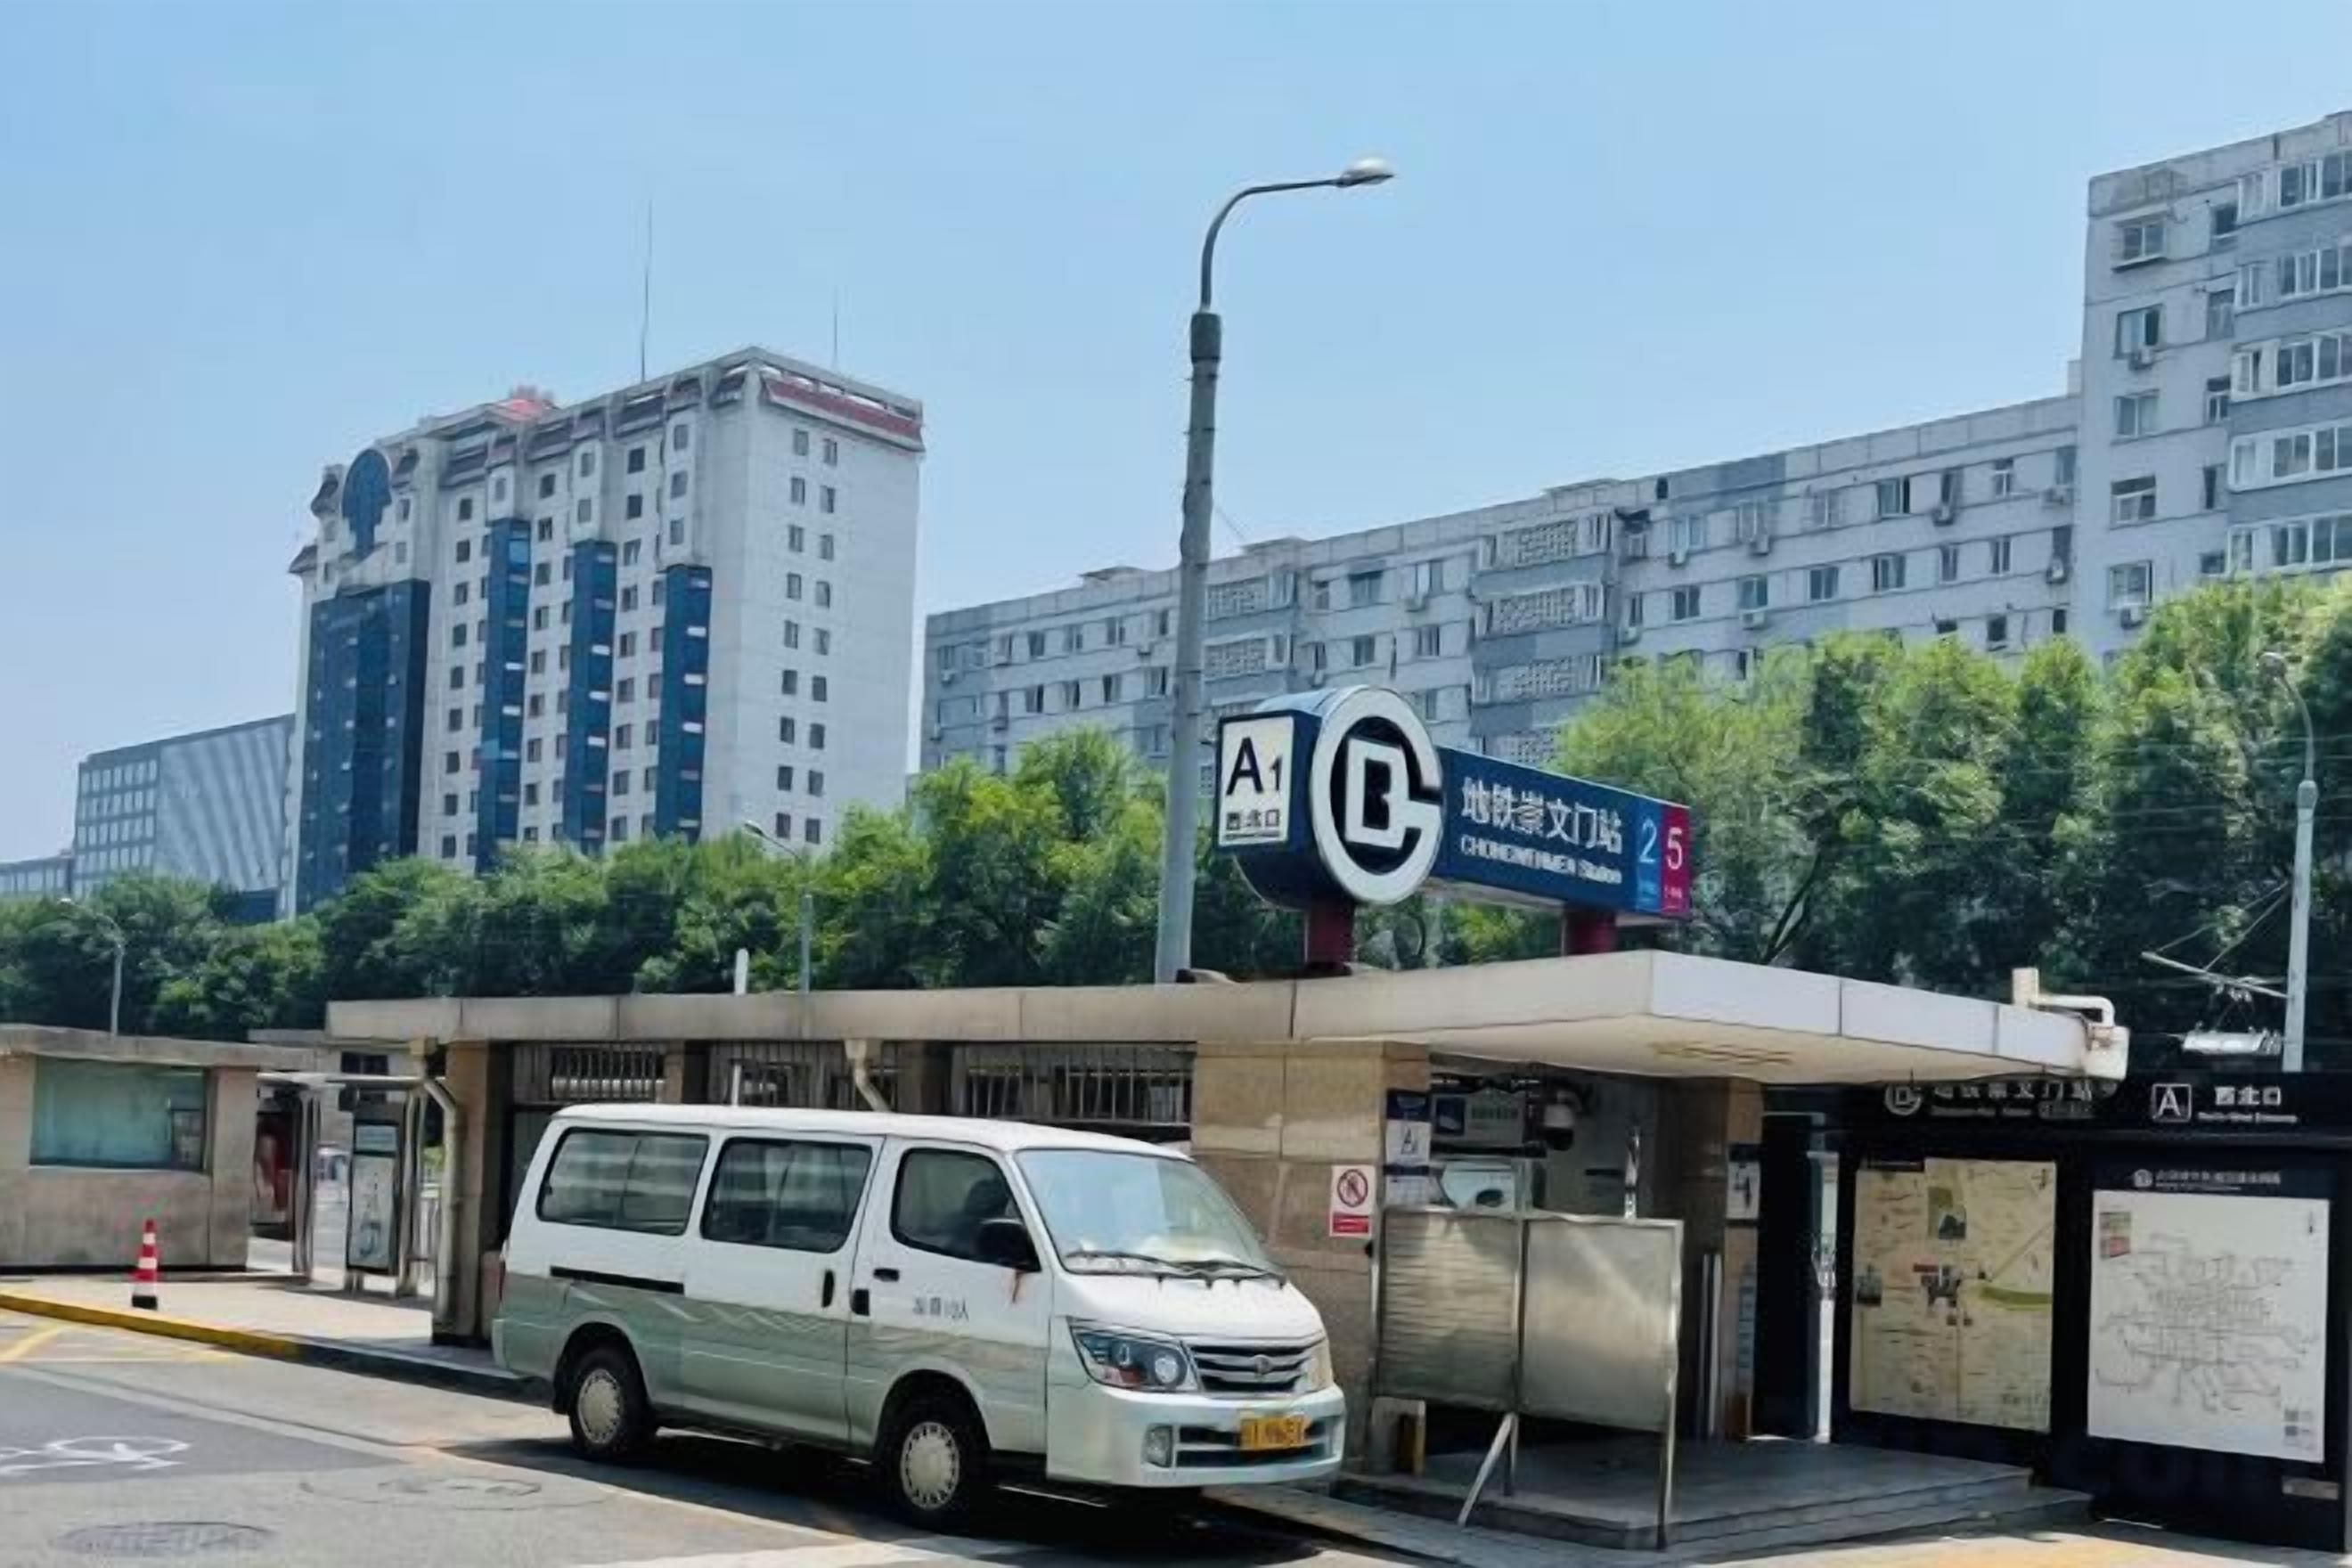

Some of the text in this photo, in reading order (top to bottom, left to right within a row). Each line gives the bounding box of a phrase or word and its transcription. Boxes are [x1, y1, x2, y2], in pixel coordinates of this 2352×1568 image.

[1639, 818, 1658, 863] 2
[1666, 826, 1682, 870] 5
[2157, 1086, 2182, 1117] A
